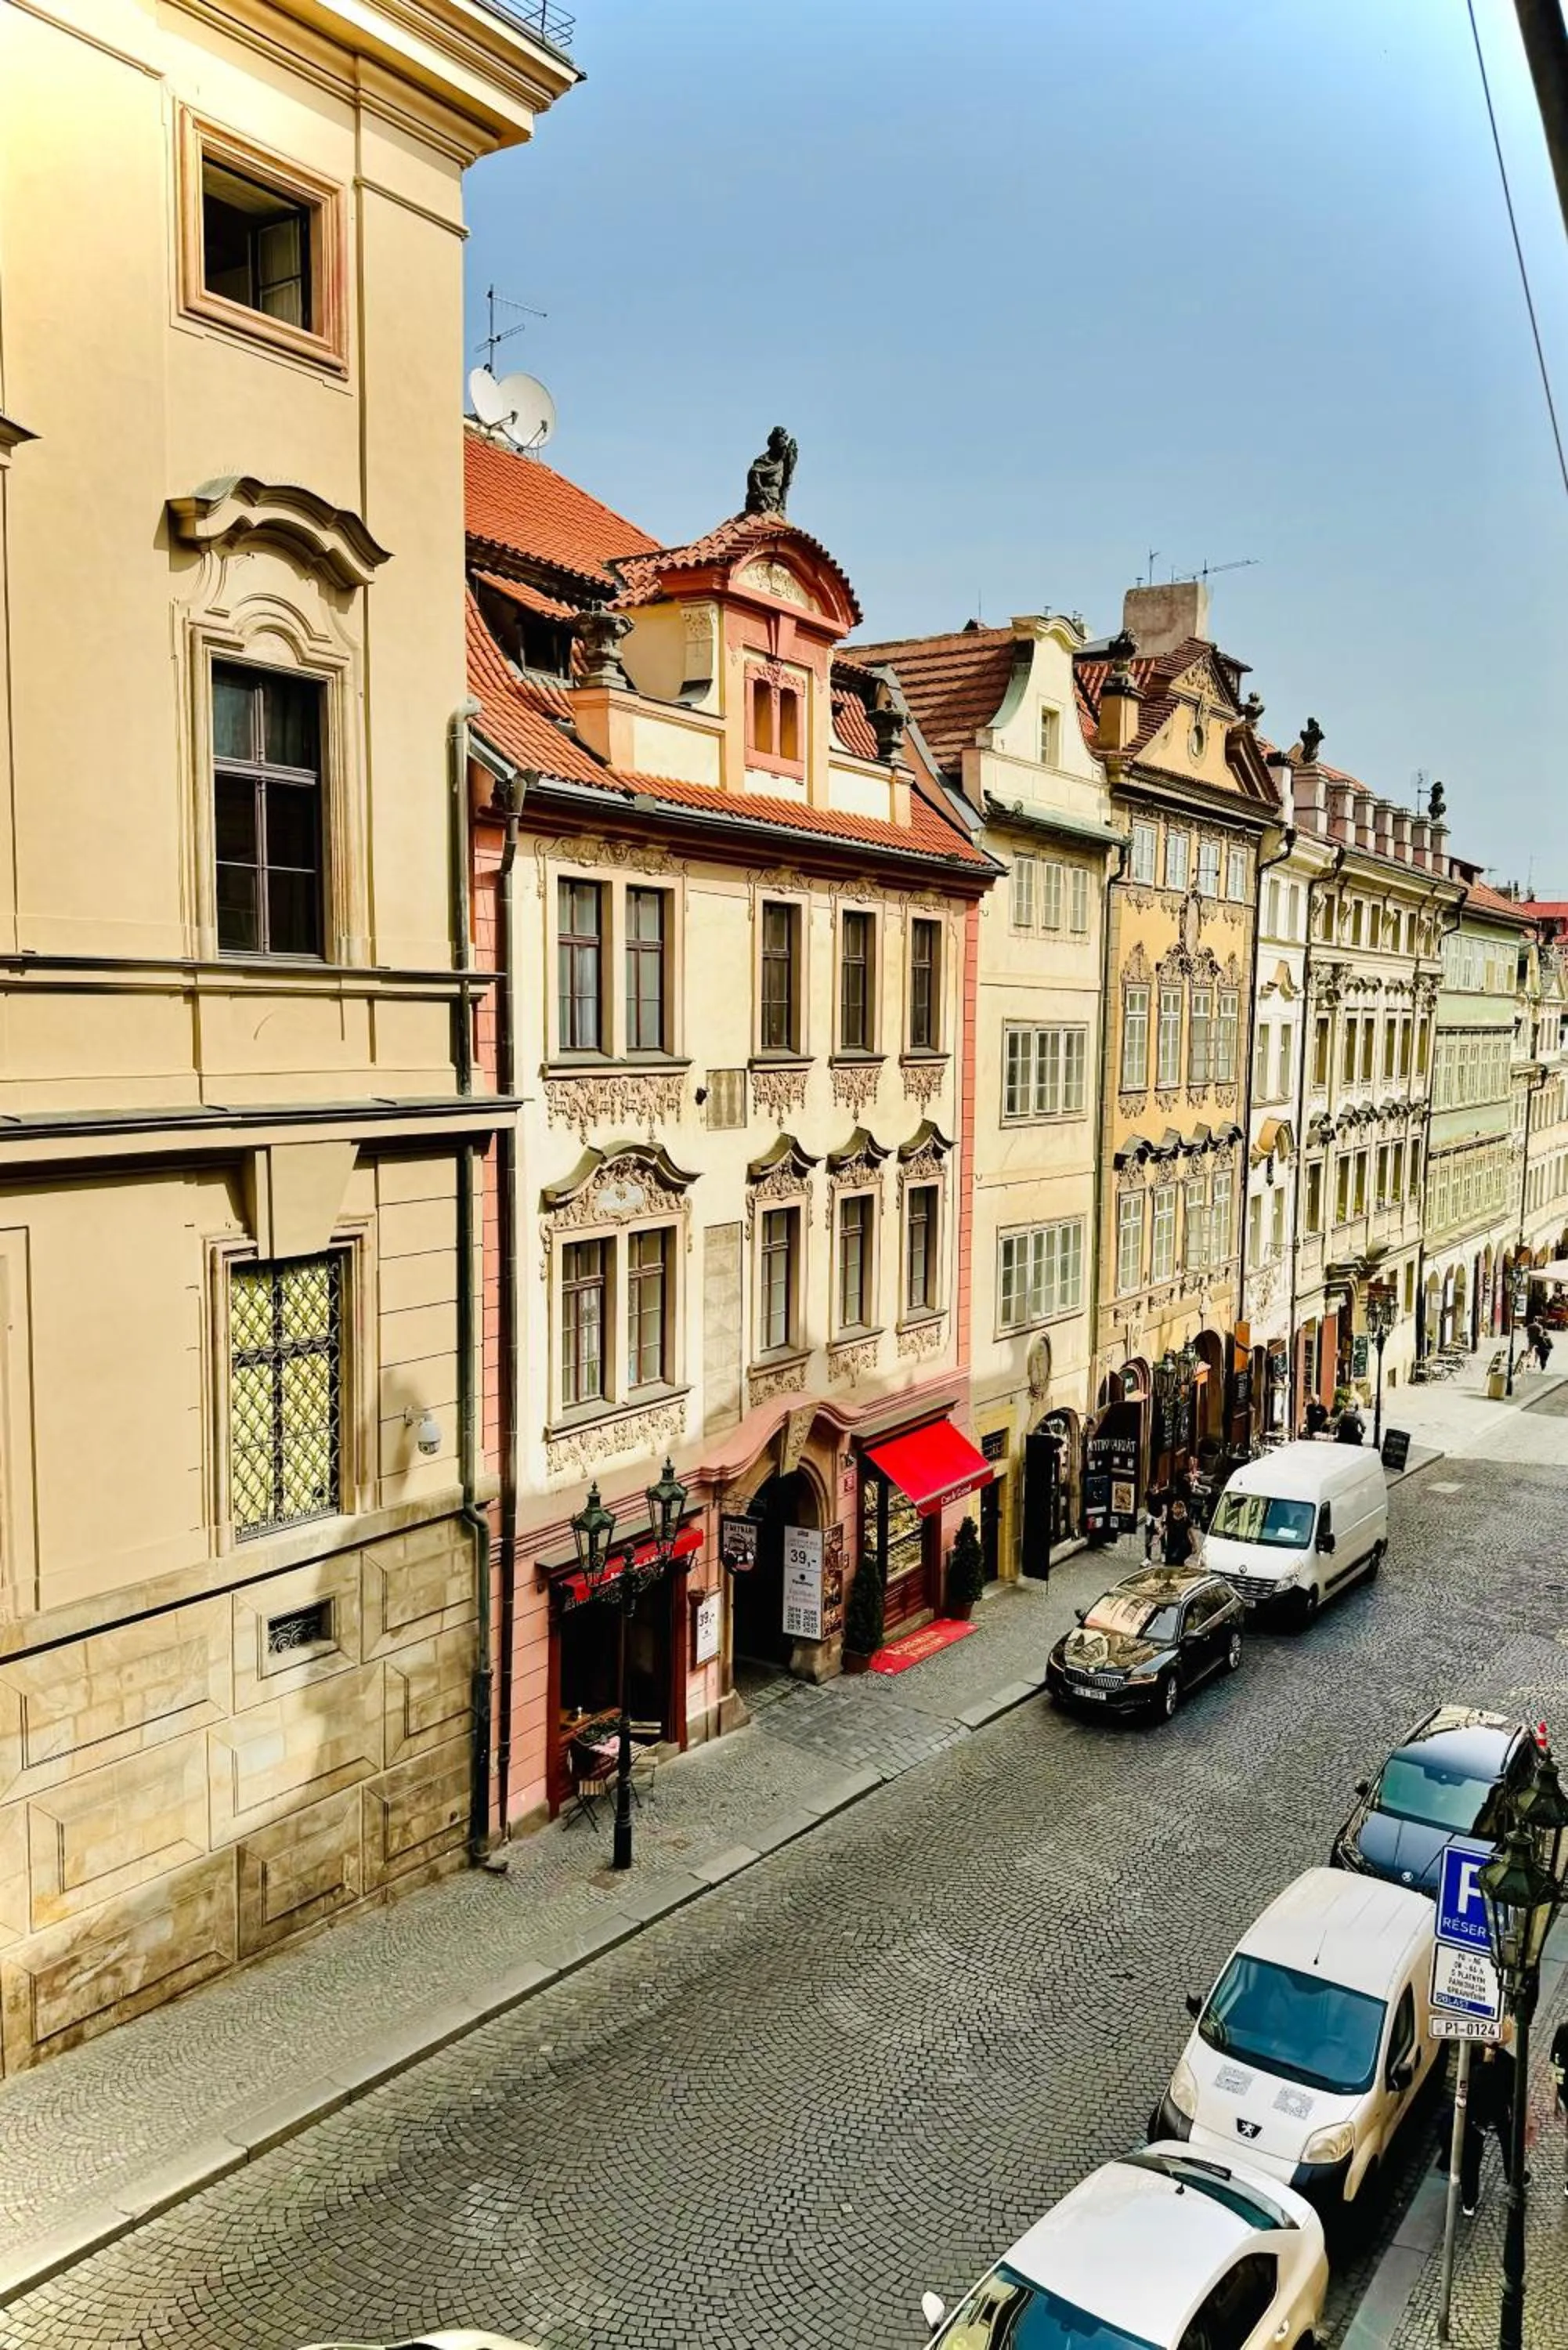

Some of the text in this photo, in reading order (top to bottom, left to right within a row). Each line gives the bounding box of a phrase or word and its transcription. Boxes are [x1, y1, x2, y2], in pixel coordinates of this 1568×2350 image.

[790, 1549, 817, 1567] 39,-
[1458, 1861, 1482, 1914] P
[1442, 1916, 1487, 1939] RÉSER
[1445, 2022, 1495, 2036] P1-0124
